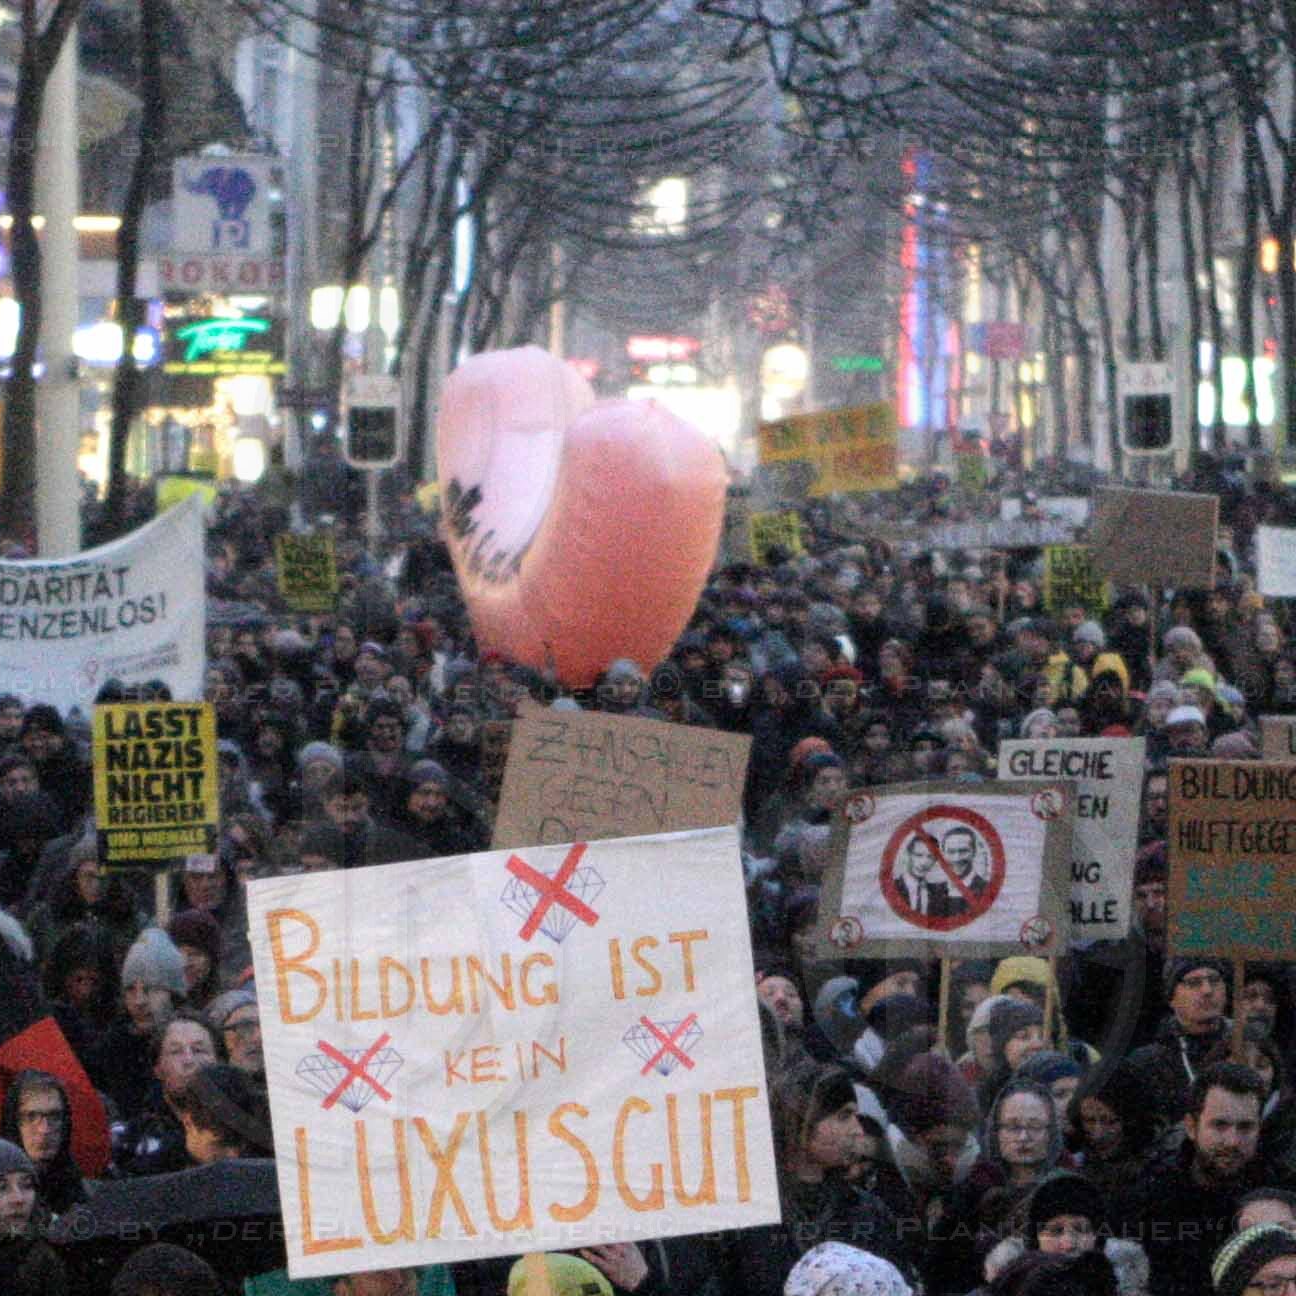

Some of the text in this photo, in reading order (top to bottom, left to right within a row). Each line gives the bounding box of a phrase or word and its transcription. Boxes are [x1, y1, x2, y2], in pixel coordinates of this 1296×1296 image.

[104, 708, 202, 739] LASST
[106, 739, 204, 770] NAZIS
[1008, 749, 1115, 779] GLEICHE
[106, 770, 204, 803] NICHT
[109, 803, 205, 825] REGIEREN
[1179, 820, 1236, 853] HILFT
[266, 907, 709, 1025] BILDUNG IST
[444, 1036, 567, 1087] KEIN
[294, 1087, 759, 1257] LUXUSGUT
